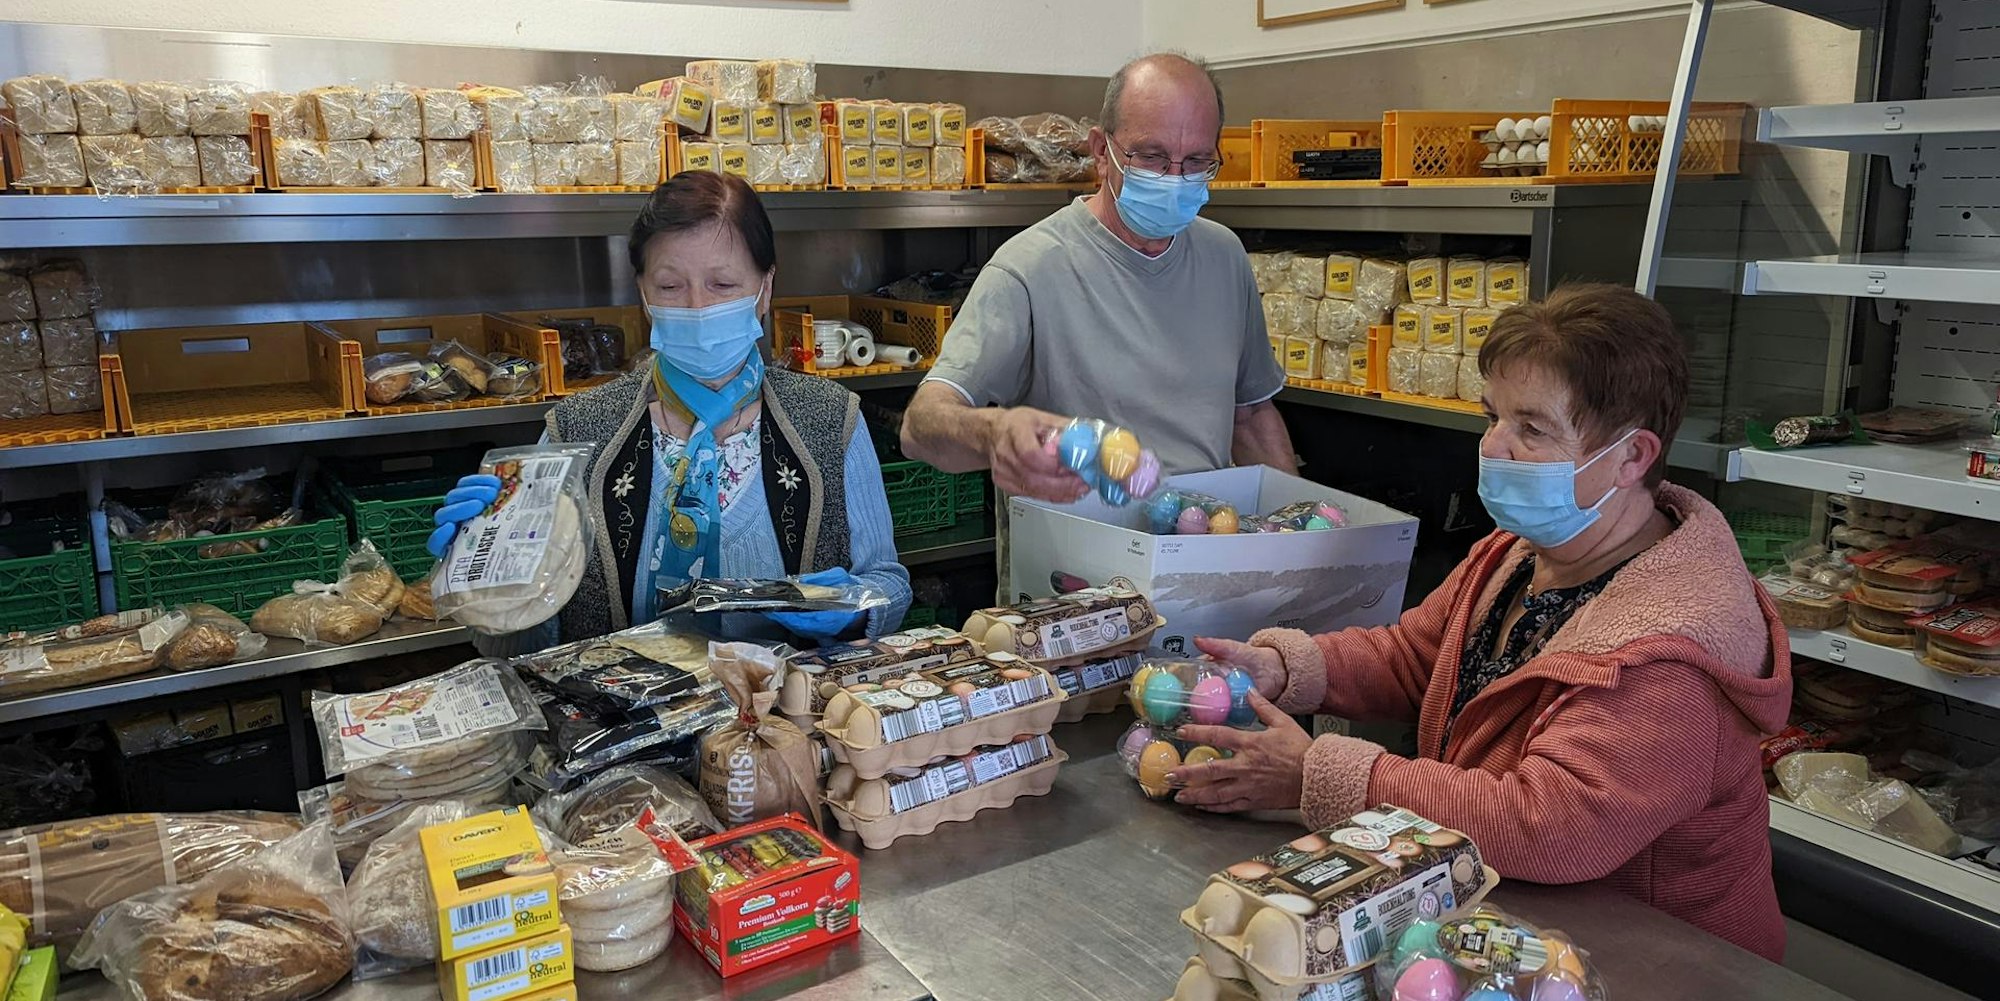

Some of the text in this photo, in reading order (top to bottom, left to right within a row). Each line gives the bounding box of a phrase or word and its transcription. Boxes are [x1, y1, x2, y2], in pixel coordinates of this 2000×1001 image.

[683, 97, 703, 108] GOLDEN
[721, 114, 740, 123] GOLDEN
[756, 116, 774, 125] GOLDEN
[795, 116, 813, 127] GOLDEN
[690, 155, 709, 164] GOLDEN
[1510, 189, 1548, 203] Bartscher
[1415, 275, 1433, 287] GOLDEN
[1453, 276, 1474, 286] GOLDEN
[1494, 277, 1515, 289] GOLDEN
[1468, 325, 1489, 335] GOLDEN
[467, 524, 501, 582] BROTTASCHE
[453, 825, 504, 842] DAVERT
[515, 910, 553, 929] neutral
[738, 900, 809, 929] Premium Vollkorn
[530, 962, 567, 980] neutral
